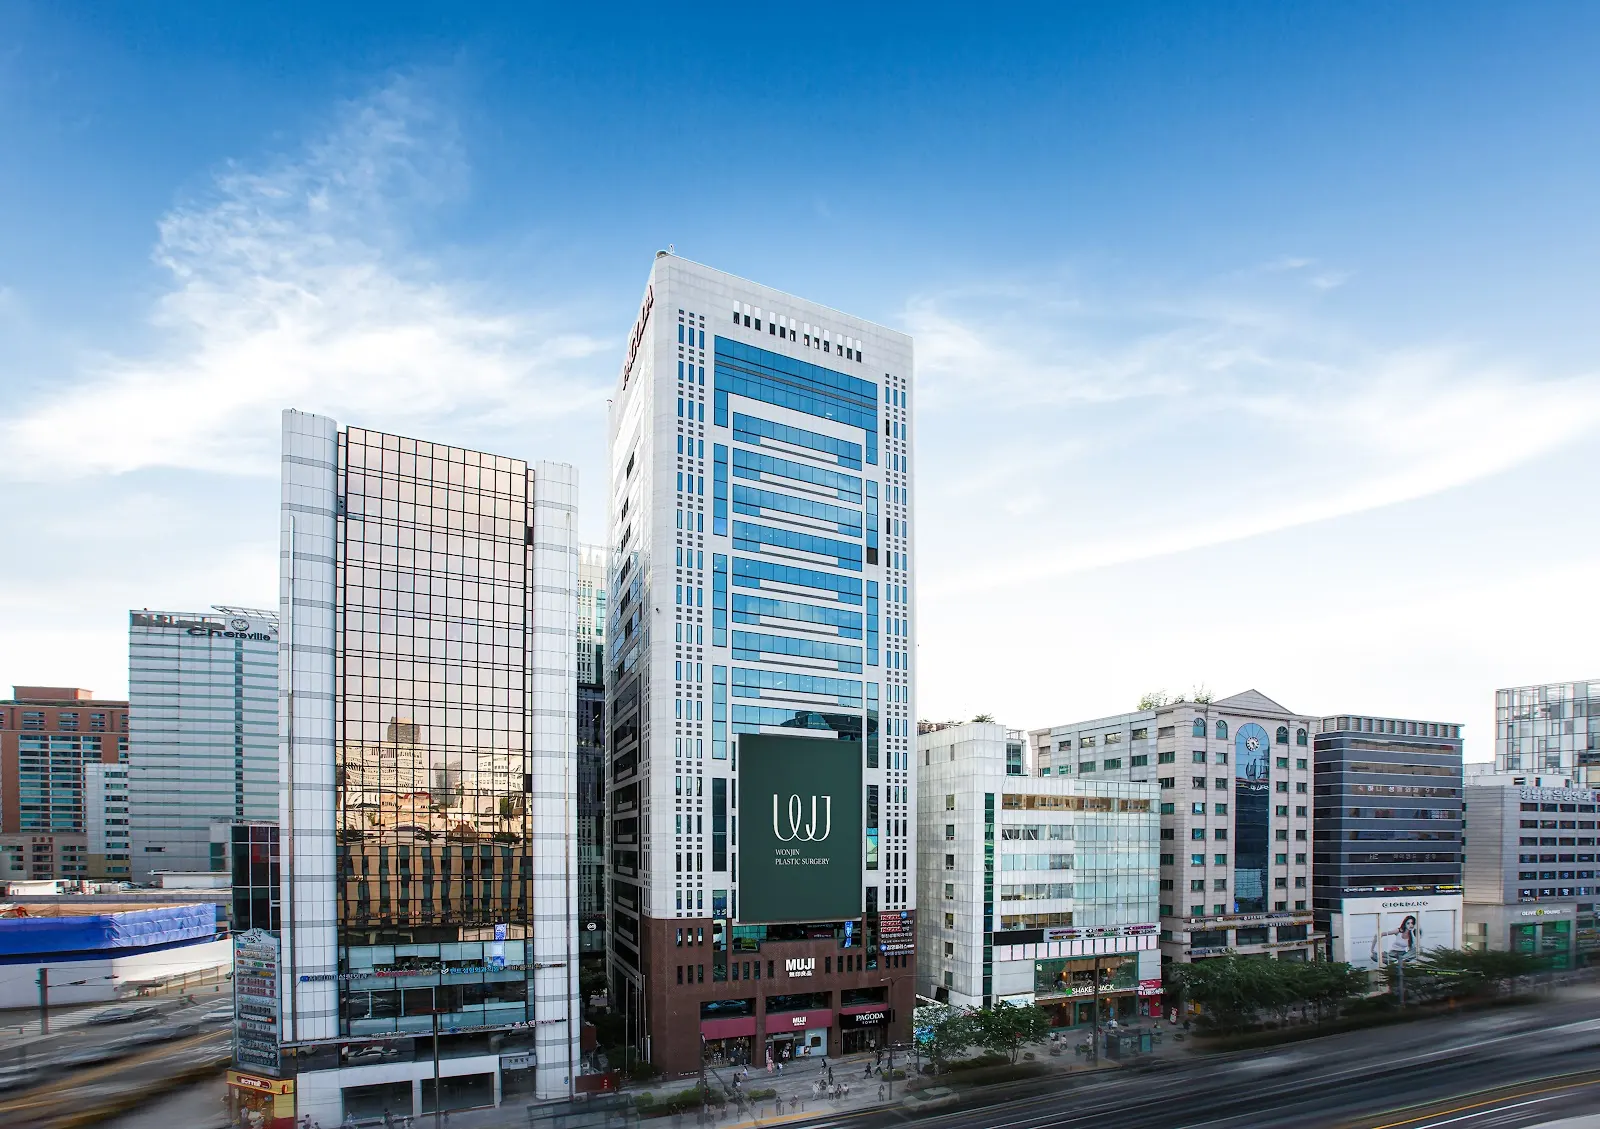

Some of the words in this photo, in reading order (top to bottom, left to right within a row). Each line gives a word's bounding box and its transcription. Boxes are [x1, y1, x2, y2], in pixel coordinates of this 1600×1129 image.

[186, 626, 271, 641] Chereville
[1381, 901, 1429, 909] GIORDANO
[785, 957, 816, 971] MUJI
[1072, 986, 1093, 995] SHAKE
[855, 1012, 885, 1021] PAGODA
